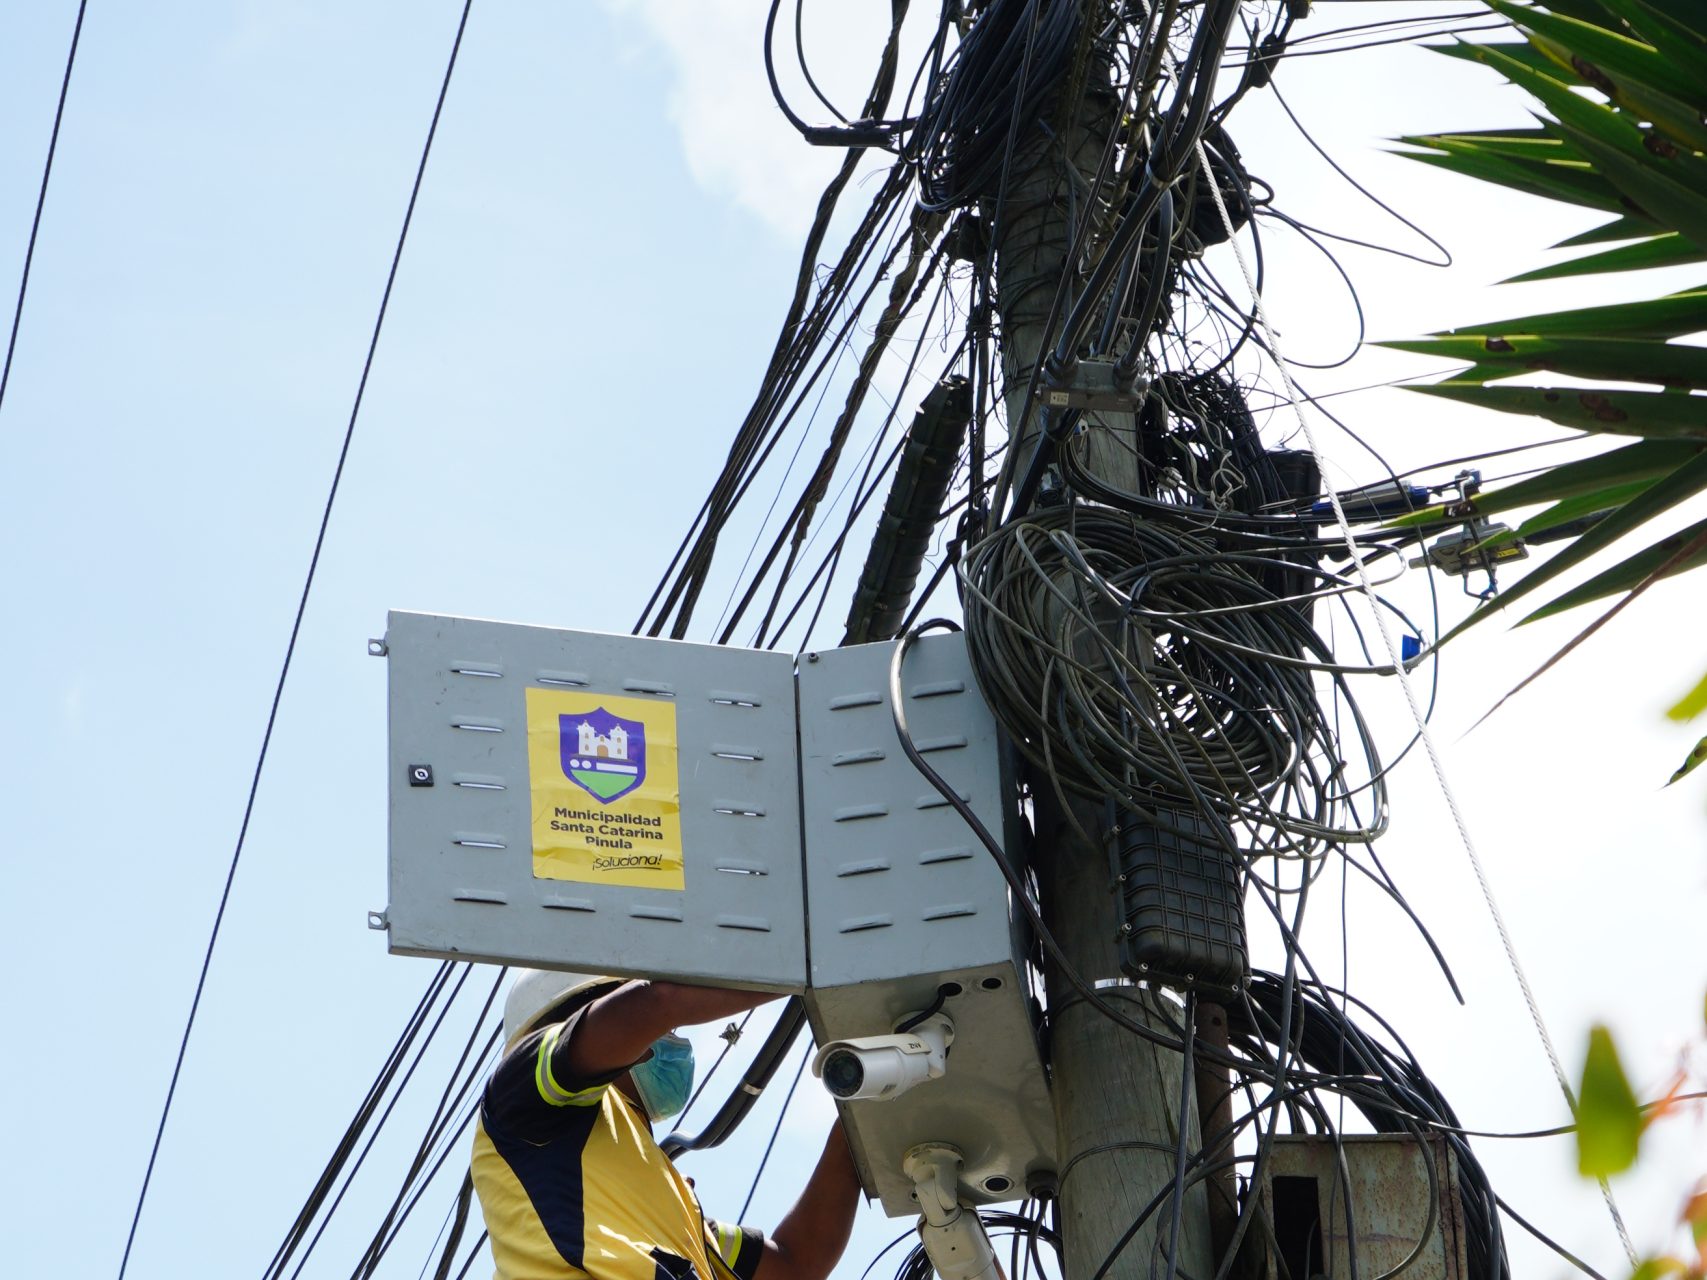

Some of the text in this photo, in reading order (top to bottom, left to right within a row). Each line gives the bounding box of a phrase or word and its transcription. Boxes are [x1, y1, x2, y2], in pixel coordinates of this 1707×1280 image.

[554, 807, 661, 827] Municipalidad
[550, 820, 664, 840] Santa Catarina
[585, 836, 633, 849] Pinula
[592, 854, 663, 871] ¡Soluciona!
